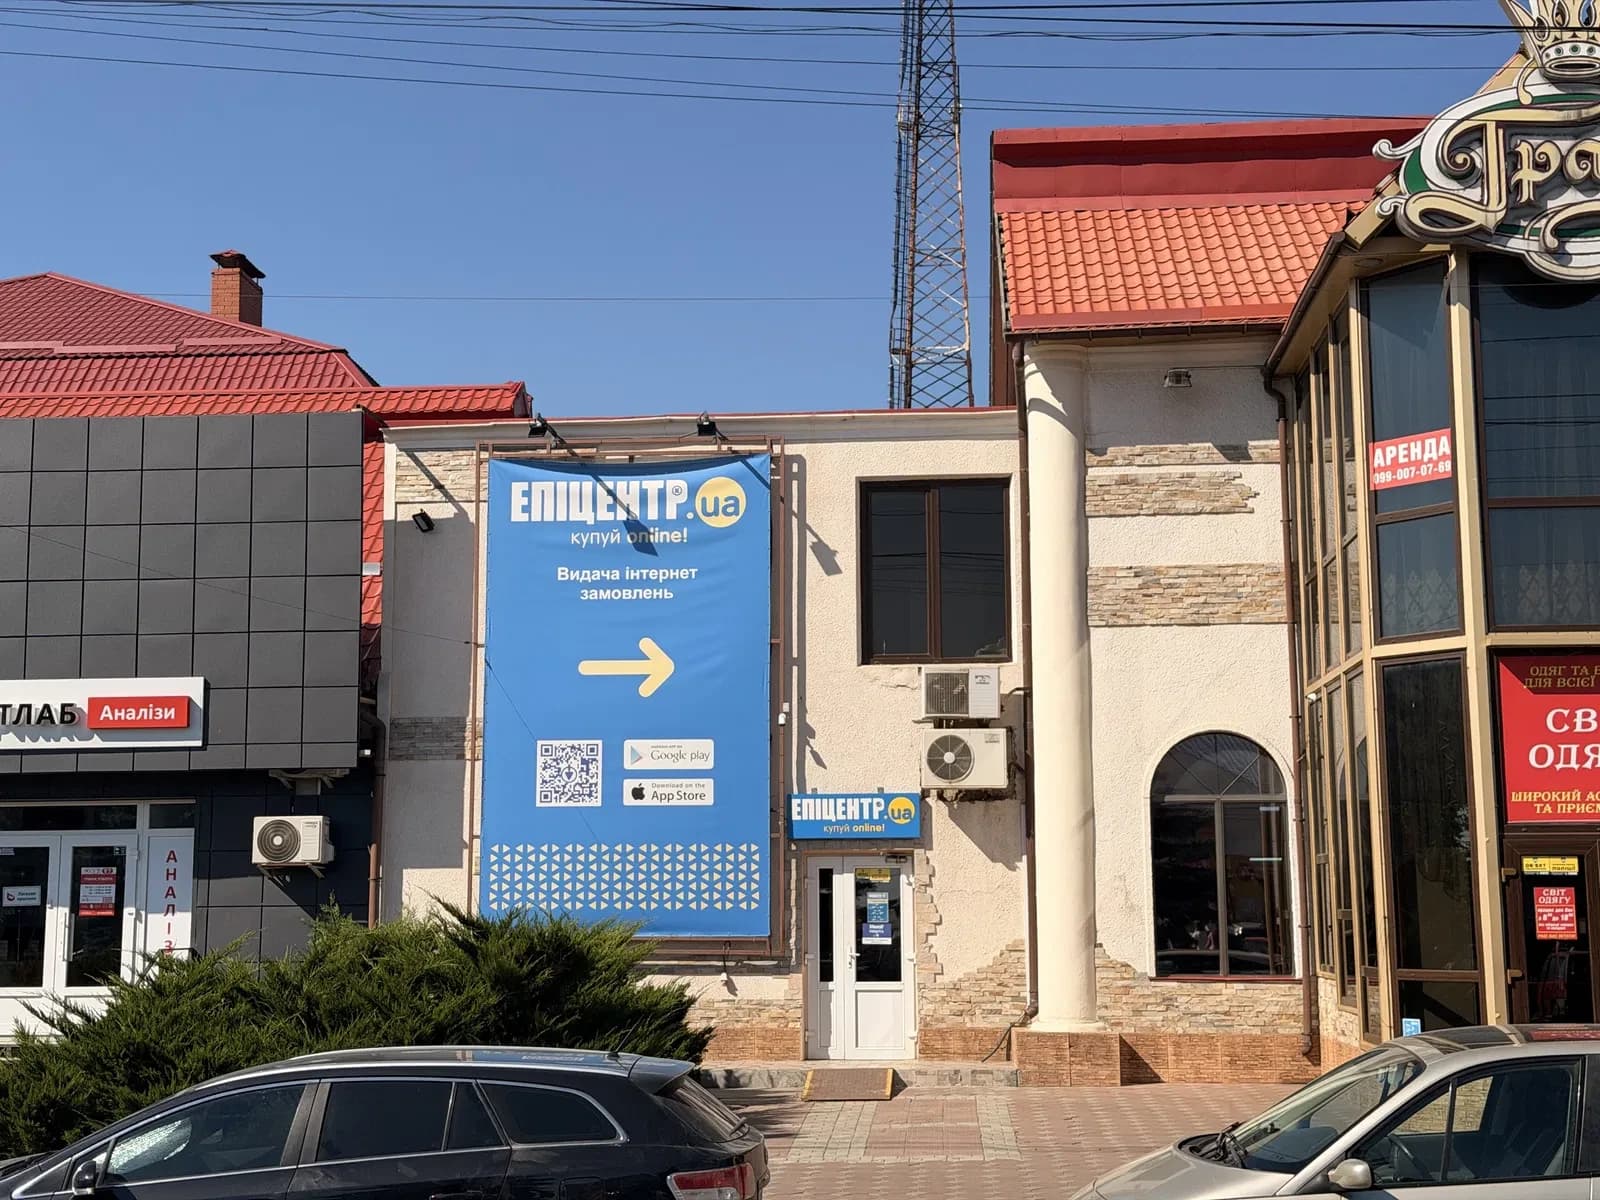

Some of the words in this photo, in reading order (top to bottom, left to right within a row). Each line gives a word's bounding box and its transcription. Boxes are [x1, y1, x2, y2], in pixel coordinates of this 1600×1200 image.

[1374, 435, 1451, 467] АРЕНДА
[571, 528, 620, 548] купуй
[627, 527, 688, 543] online!
[557, 566, 620, 583] Видача
[625, 566, 698, 583] інтернет
[580, 587, 674, 600] замовлень
[1530, 665, 1566, 676] ОДЯГ
[1571, 665, 1590, 675] ТА
[1524, 677, 1552, 688] ДЛЯ
[1557, 675, 1595, 688] ВСІЄЇ
[100, 704, 175, 721] Аналізи
[650, 749, 687, 763] Google
[690, 749, 710, 762] play
[651, 790, 674, 803] App
[676, 790, 706, 801] Store
[1511, 789, 1581, 802] ШИРОКИЙ
[1534, 803, 1552, 813] ТА
[823, 824, 849, 833] купуй
